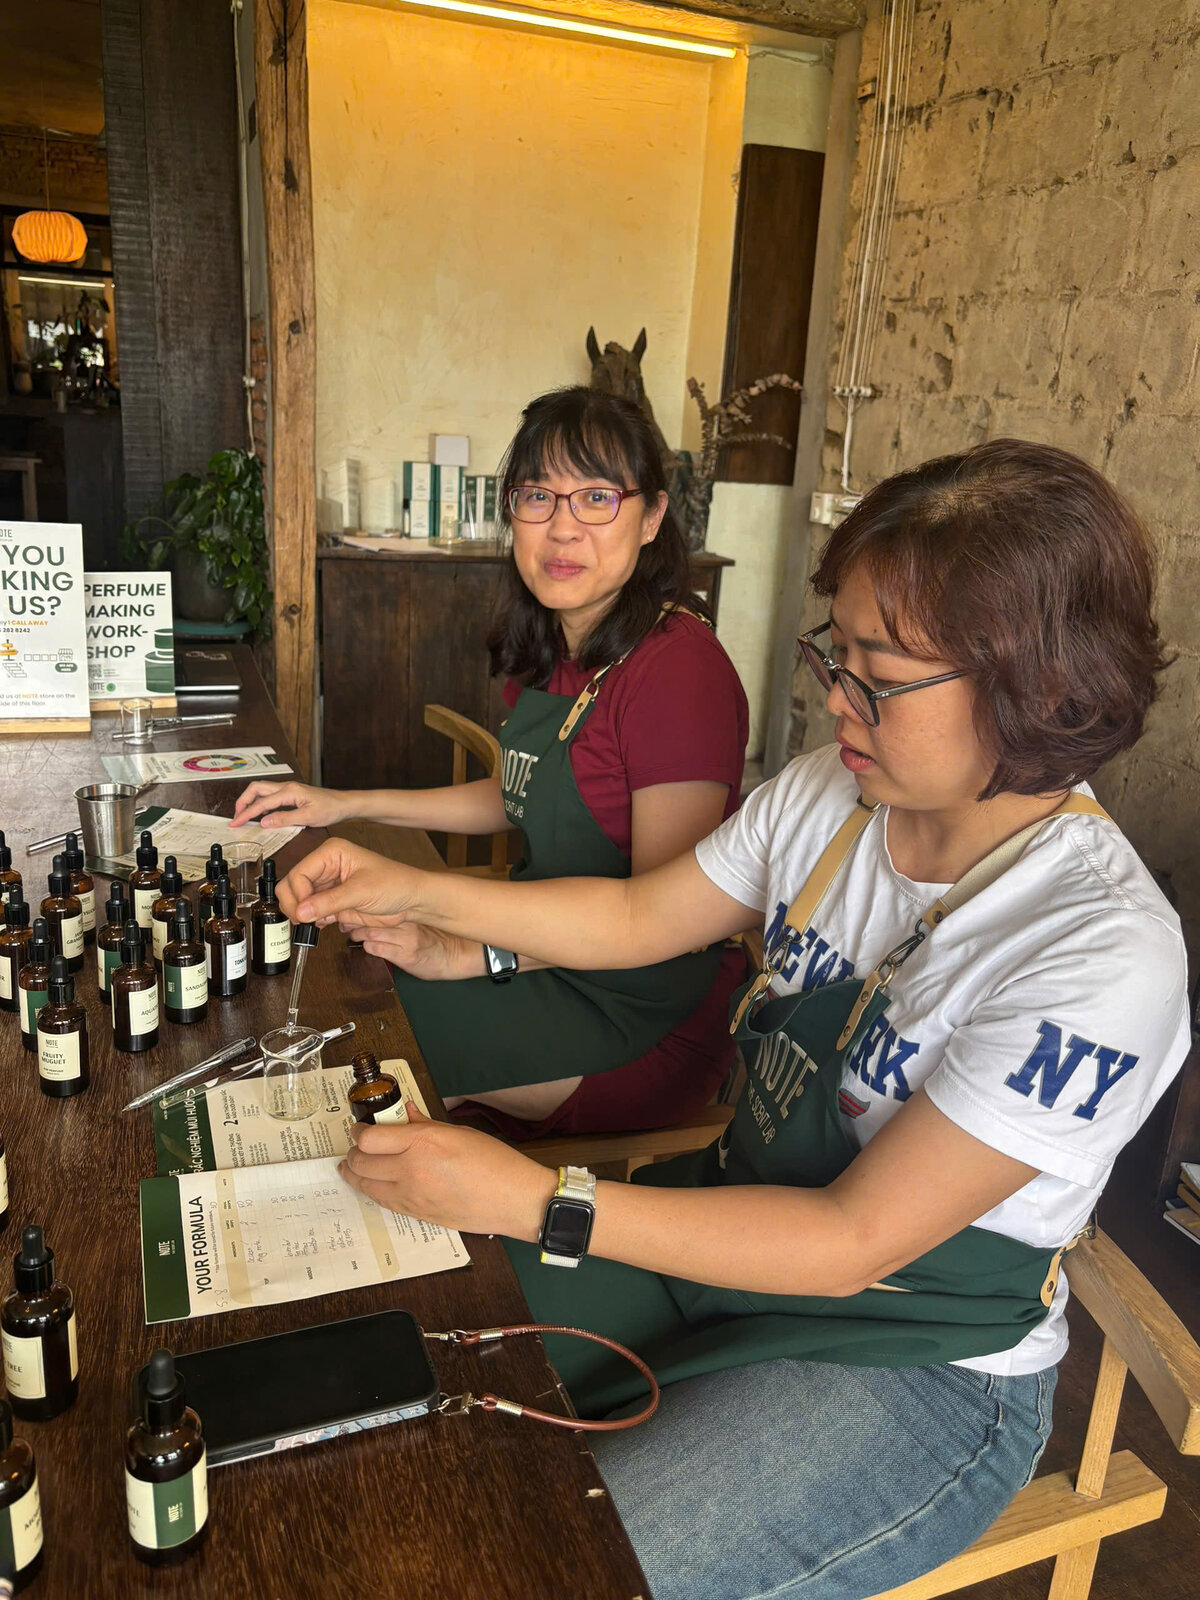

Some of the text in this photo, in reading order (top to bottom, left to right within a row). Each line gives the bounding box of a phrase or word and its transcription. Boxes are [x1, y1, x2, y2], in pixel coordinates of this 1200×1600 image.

[2, 545, 64, 566] YOU
[2, 570, 73, 591] KING
[84, 584, 166, 596] PERFUME
[8, 596, 61, 616] US?
[85, 604, 155, 617] MAKING
[87, 625, 148, 638] WORK-
[87, 645, 135, 658] SHOP
[501, 747, 539, 798] NOTE
[763, 901, 855, 992] NEW
[42, 1056, 66, 1064] MUGUET
[850, 1013, 920, 1102] RK
[754, 1031, 818, 1120] NOTE
[1004, 1020, 1139, 1120] NY
[188, 1158, 204, 1172] RẮC
[159, 1241, 170, 1256] NOTE
[188, 1196, 212, 1294] YOUR FORMULA
[168, 1504, 179, 1522] NOTE
